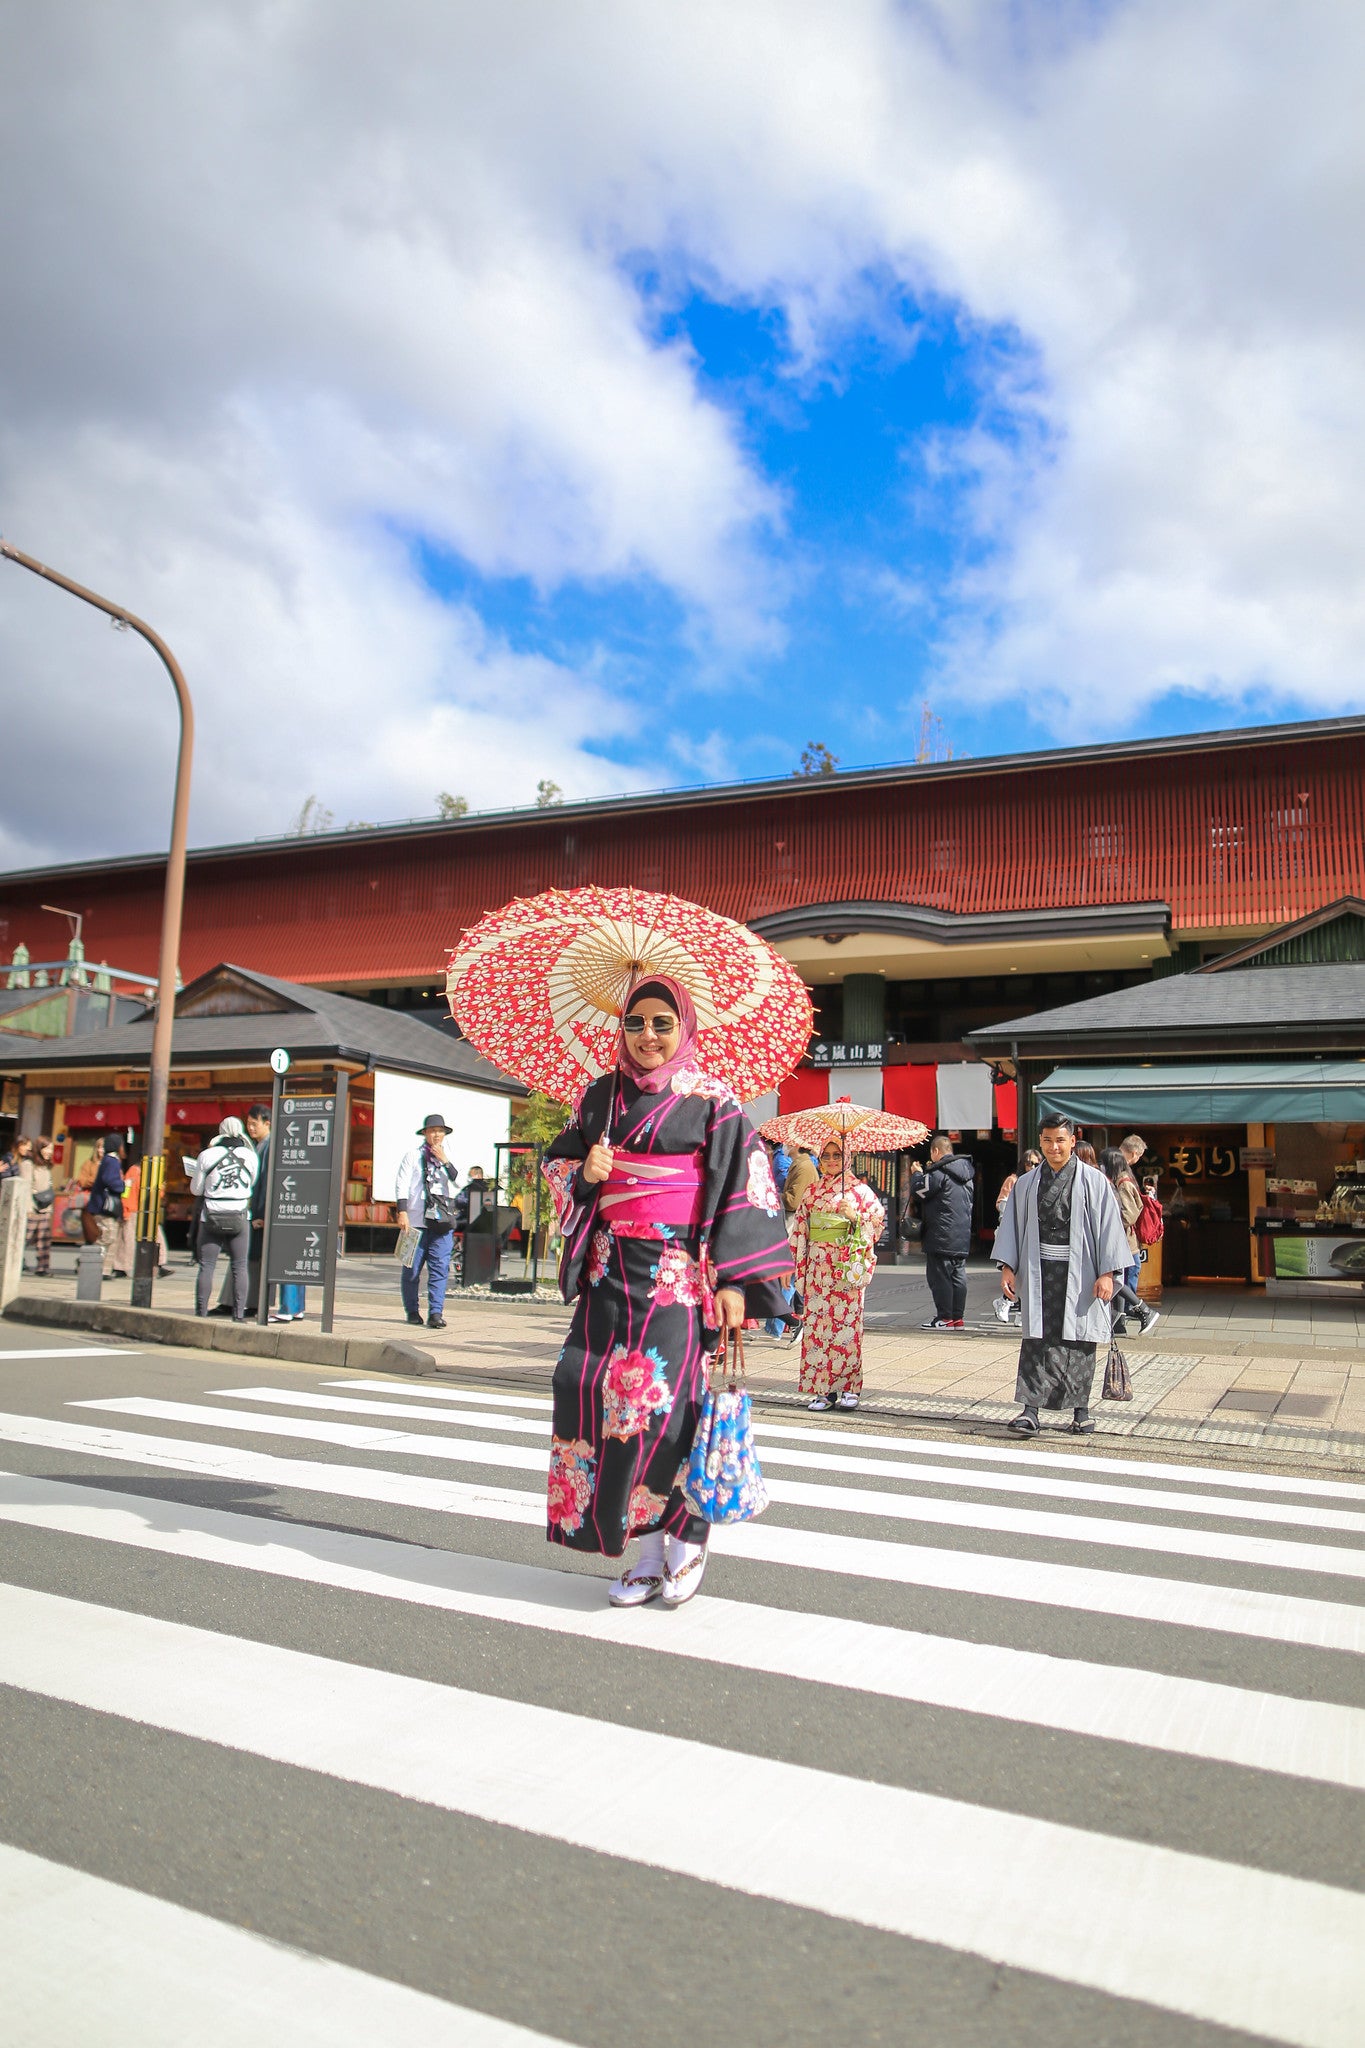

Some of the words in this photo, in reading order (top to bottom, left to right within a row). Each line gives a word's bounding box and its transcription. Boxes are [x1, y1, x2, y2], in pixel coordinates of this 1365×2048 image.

[832, 1044, 882, 1060] 嵐山駅
[282, 1149, 306, 1159] 天龍寺
[1169, 1146, 1235, 1177] もり
[279, 1204, 318, 1214] 竹林の小径
[295, 1260, 320, 1270] 渡月橋
